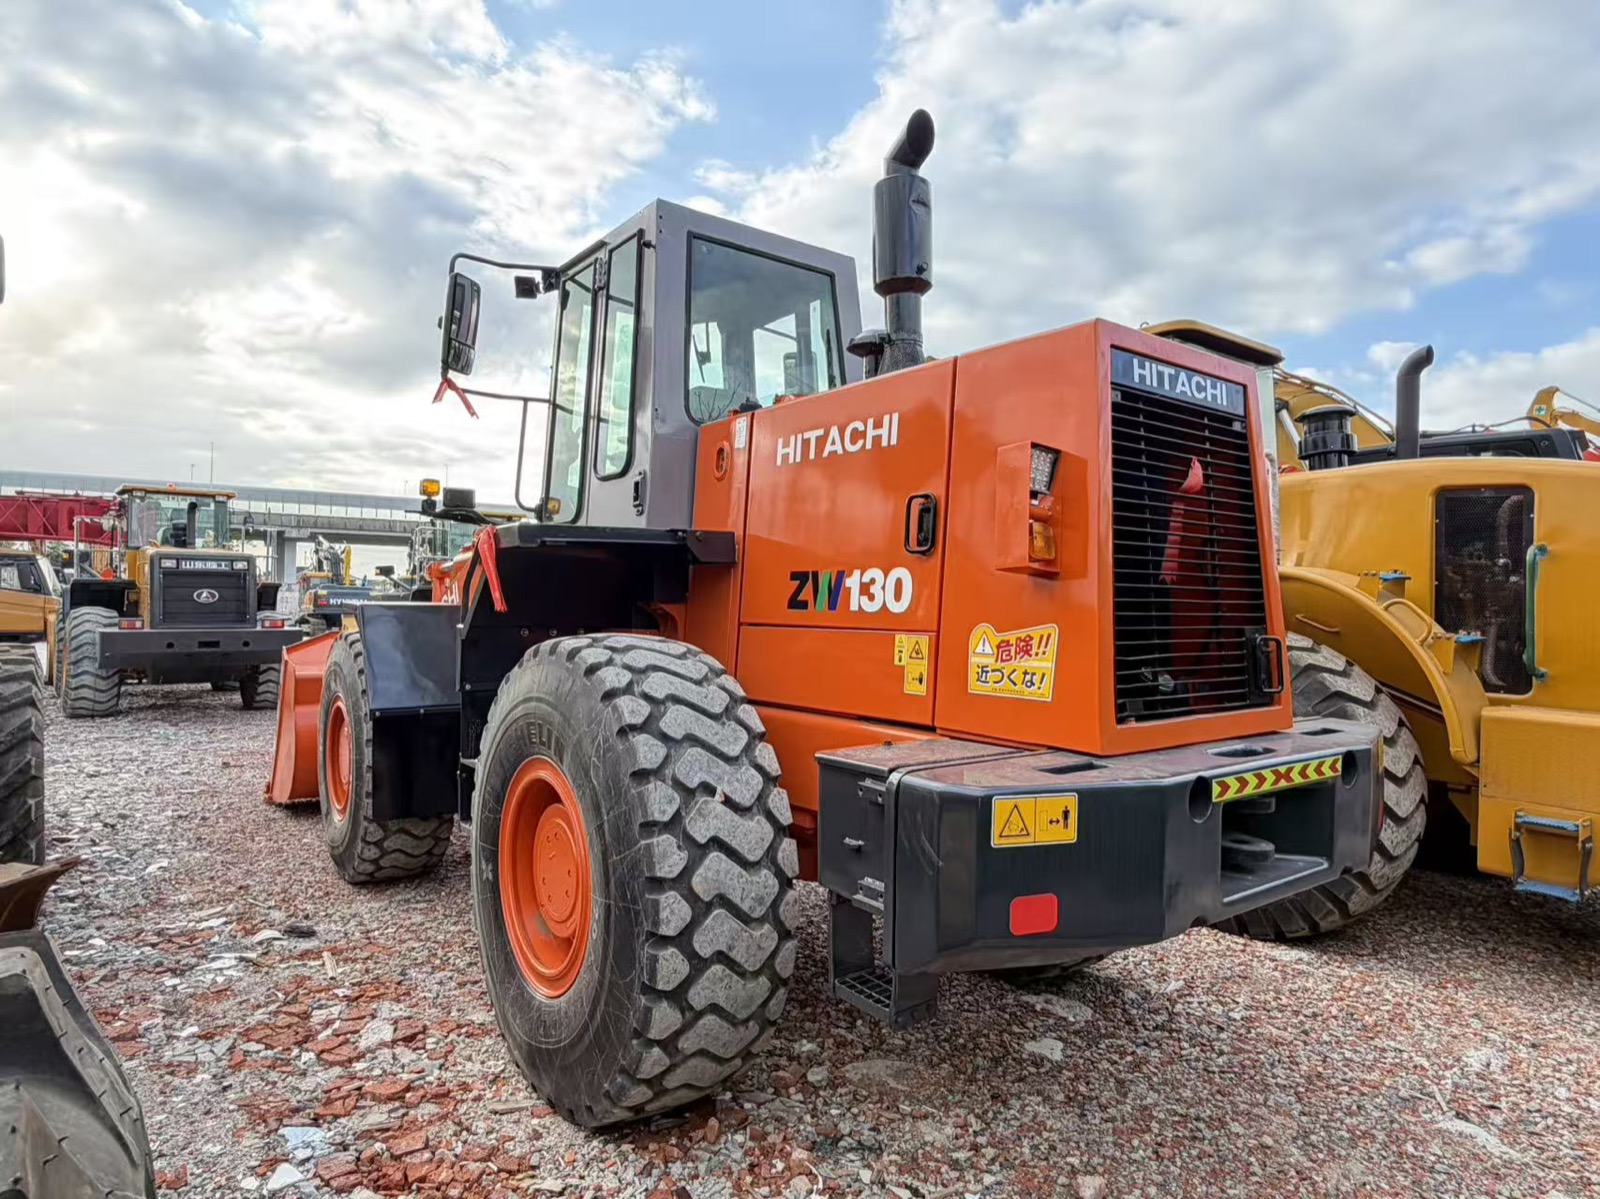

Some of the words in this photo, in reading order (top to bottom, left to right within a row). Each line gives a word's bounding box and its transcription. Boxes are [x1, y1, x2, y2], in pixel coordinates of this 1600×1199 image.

[1132, 358, 1228, 406] HITACHI
[776, 412, 899, 467] HITACHI
[786, 566, 913, 613] ZW130
[975, 664, 1047, 691] 近づくな!
